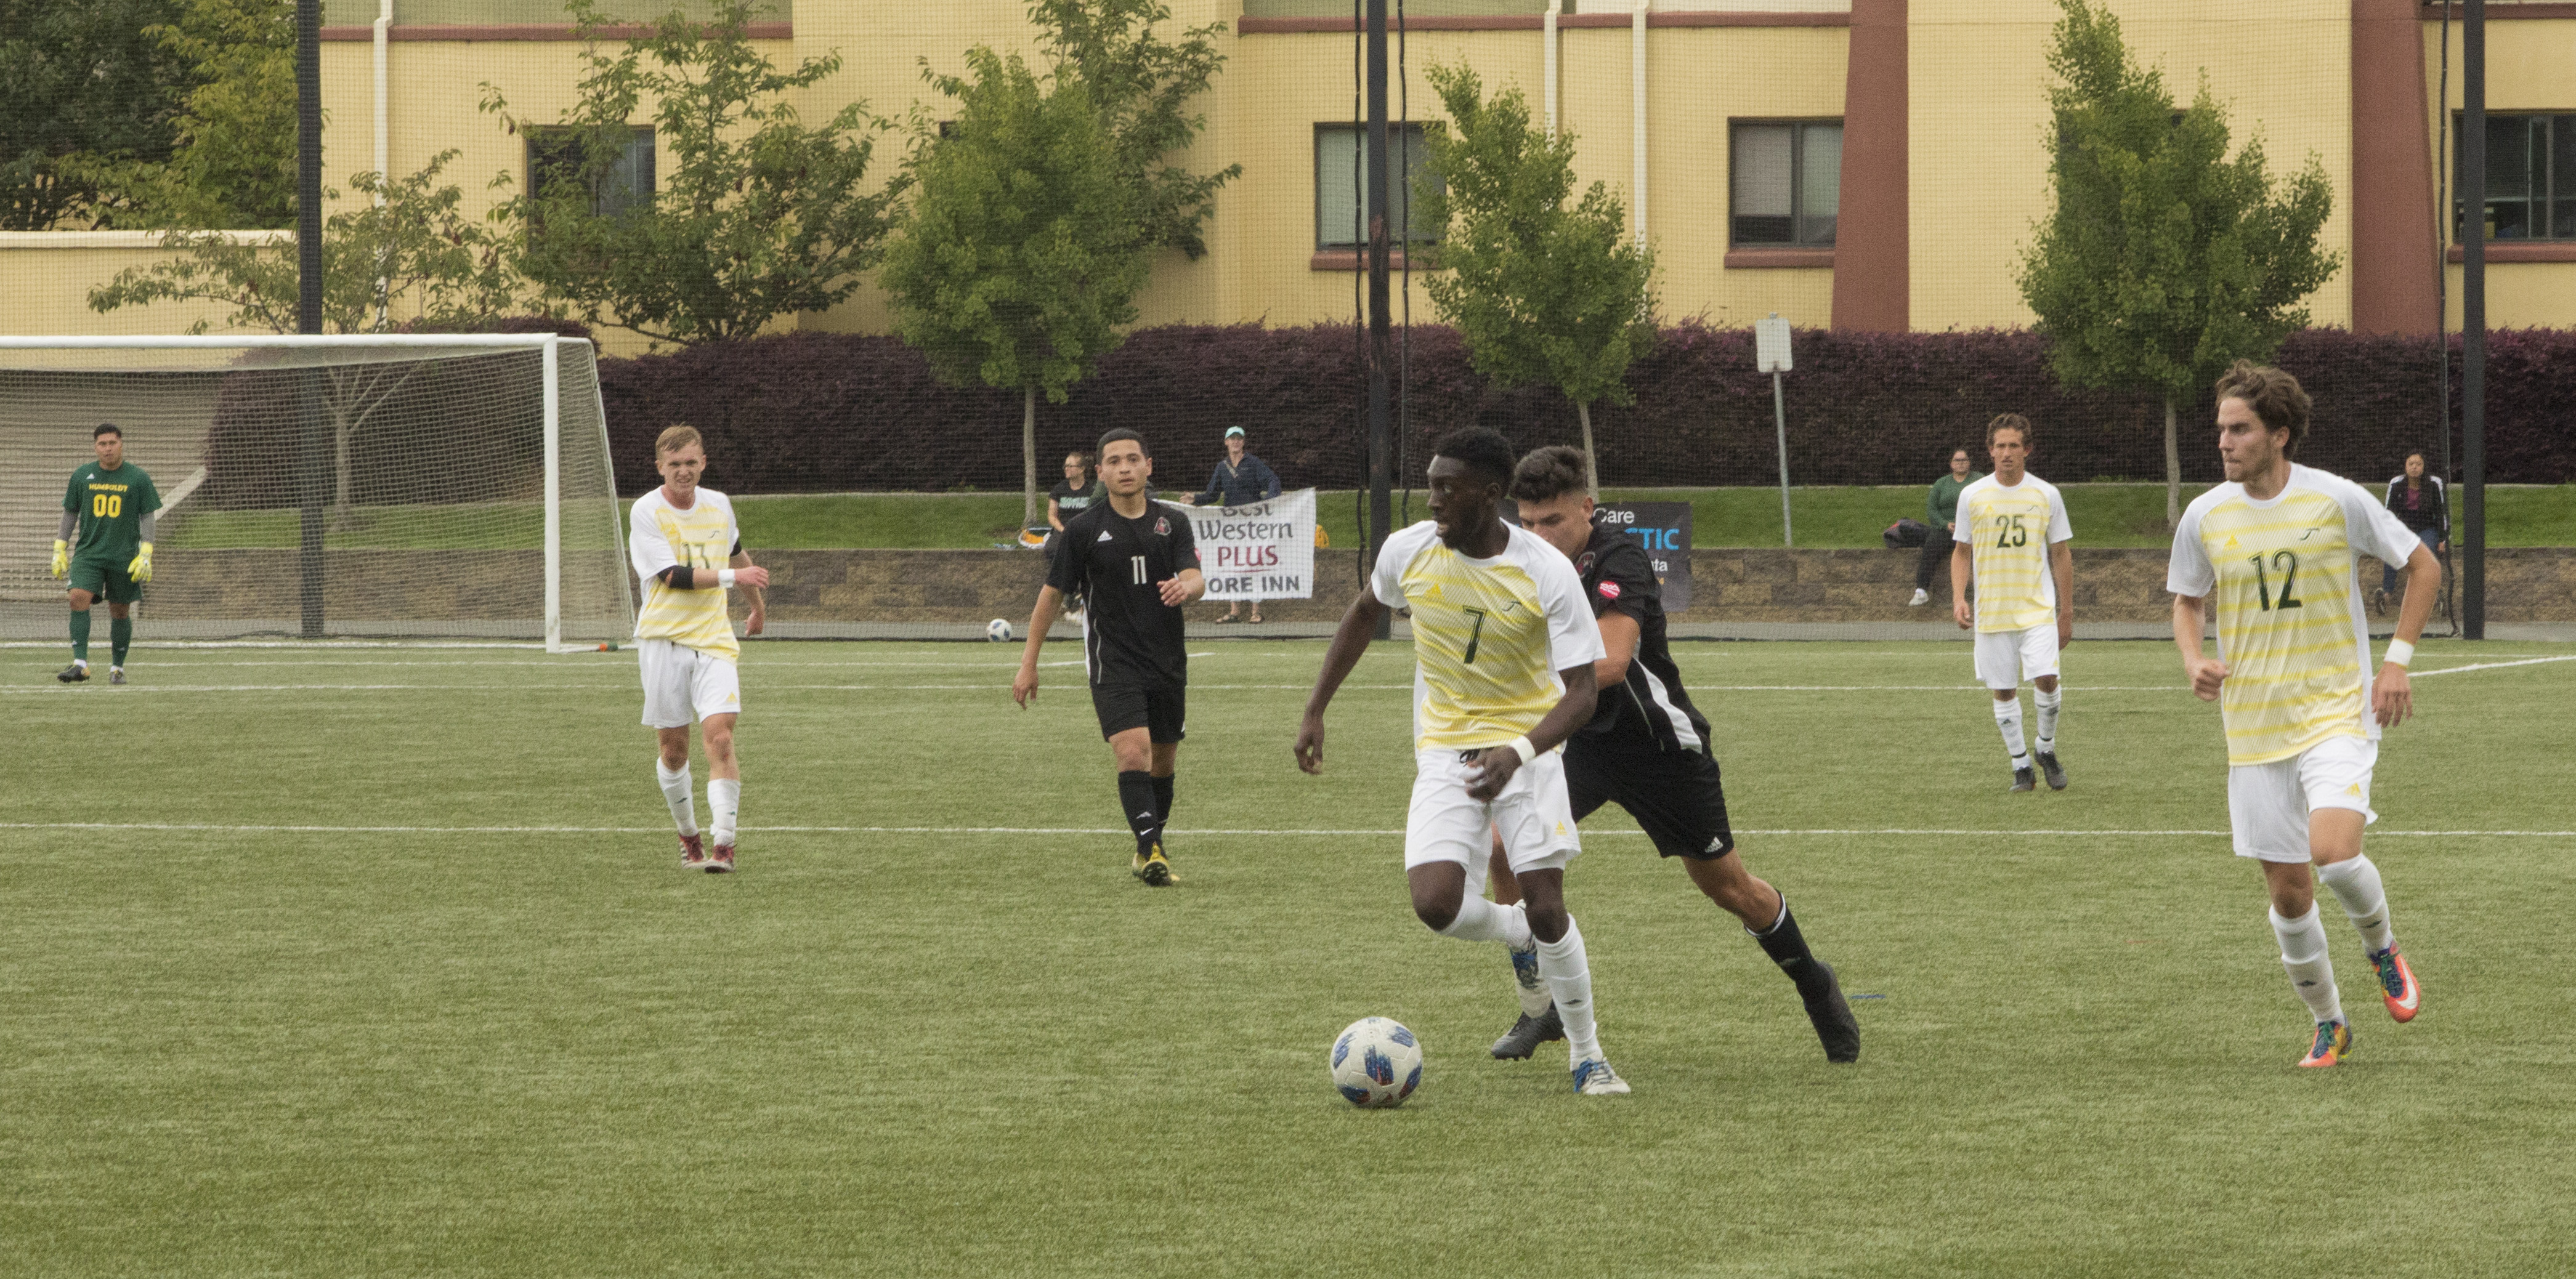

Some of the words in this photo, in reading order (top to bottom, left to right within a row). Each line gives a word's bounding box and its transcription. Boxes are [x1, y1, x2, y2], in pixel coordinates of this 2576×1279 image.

[89, 483, 128, 492] HUMBOLDT
[93, 493, 121, 518] 00
[1593, 508, 1635, 523] Care
[1197, 519, 1293, 540] Western
[1624, 528, 1680, 550] TIC
[1996, 514, 2027, 548] 25
[682, 542, 710, 570] 13
[1217, 545, 1278, 567] PLUS
[1651, 559, 1669, 572] ta
[1131, 555, 1147, 584] 11
[2248, 548, 2303, 611] 12
[1204, 577, 1254, 593] ORE
[1263, 576, 1300, 592] INN
[1462, 605, 1488, 664] 7
